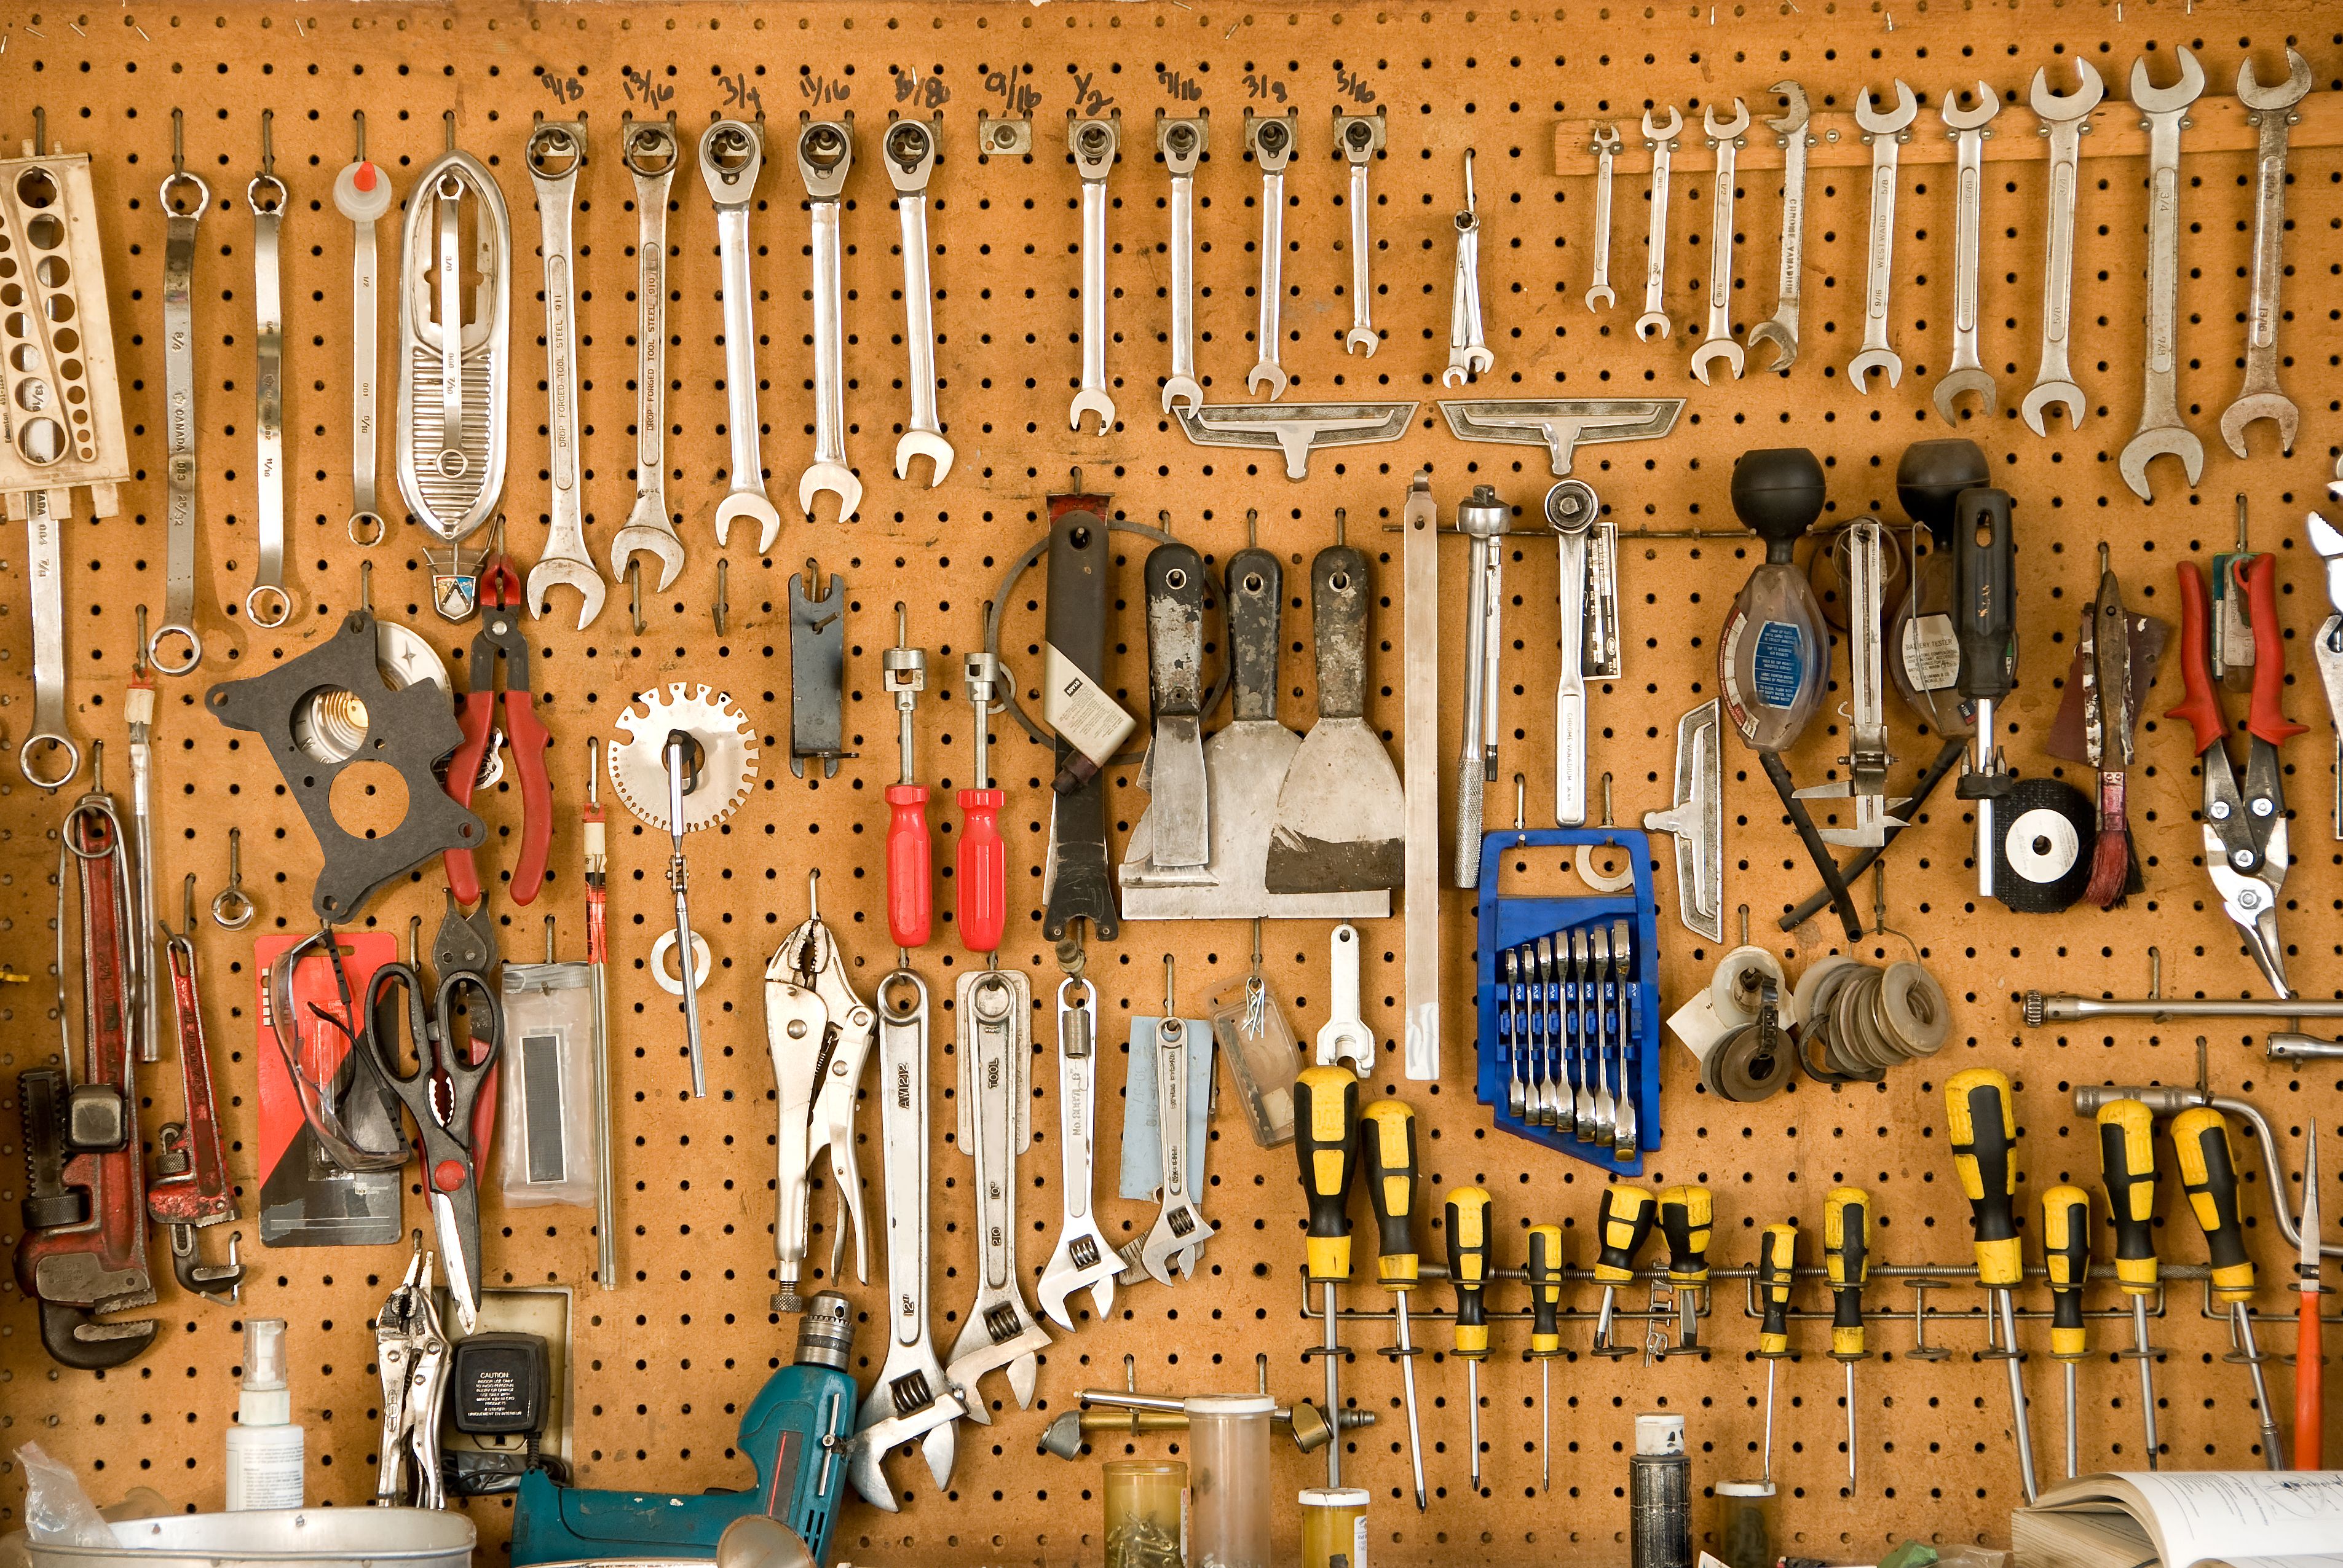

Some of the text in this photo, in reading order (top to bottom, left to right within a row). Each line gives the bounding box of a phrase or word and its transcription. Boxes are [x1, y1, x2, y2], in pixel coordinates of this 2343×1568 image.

[717, 73, 762, 110] 3/4
[799, 74, 851, 106] 11/16
[984, 65, 1042, 113] 9/16
[1336, 69, 1376, 104] 5/16
[1877, 214, 1887, 269] WESTWARD
[175, 408, 184, 452] CANADA
[898, 1062, 910, 1109] AW1212
[988, 1057, 1002, 1247] TOOL 10" 210
[901, 1294, 916, 1317] 12"
